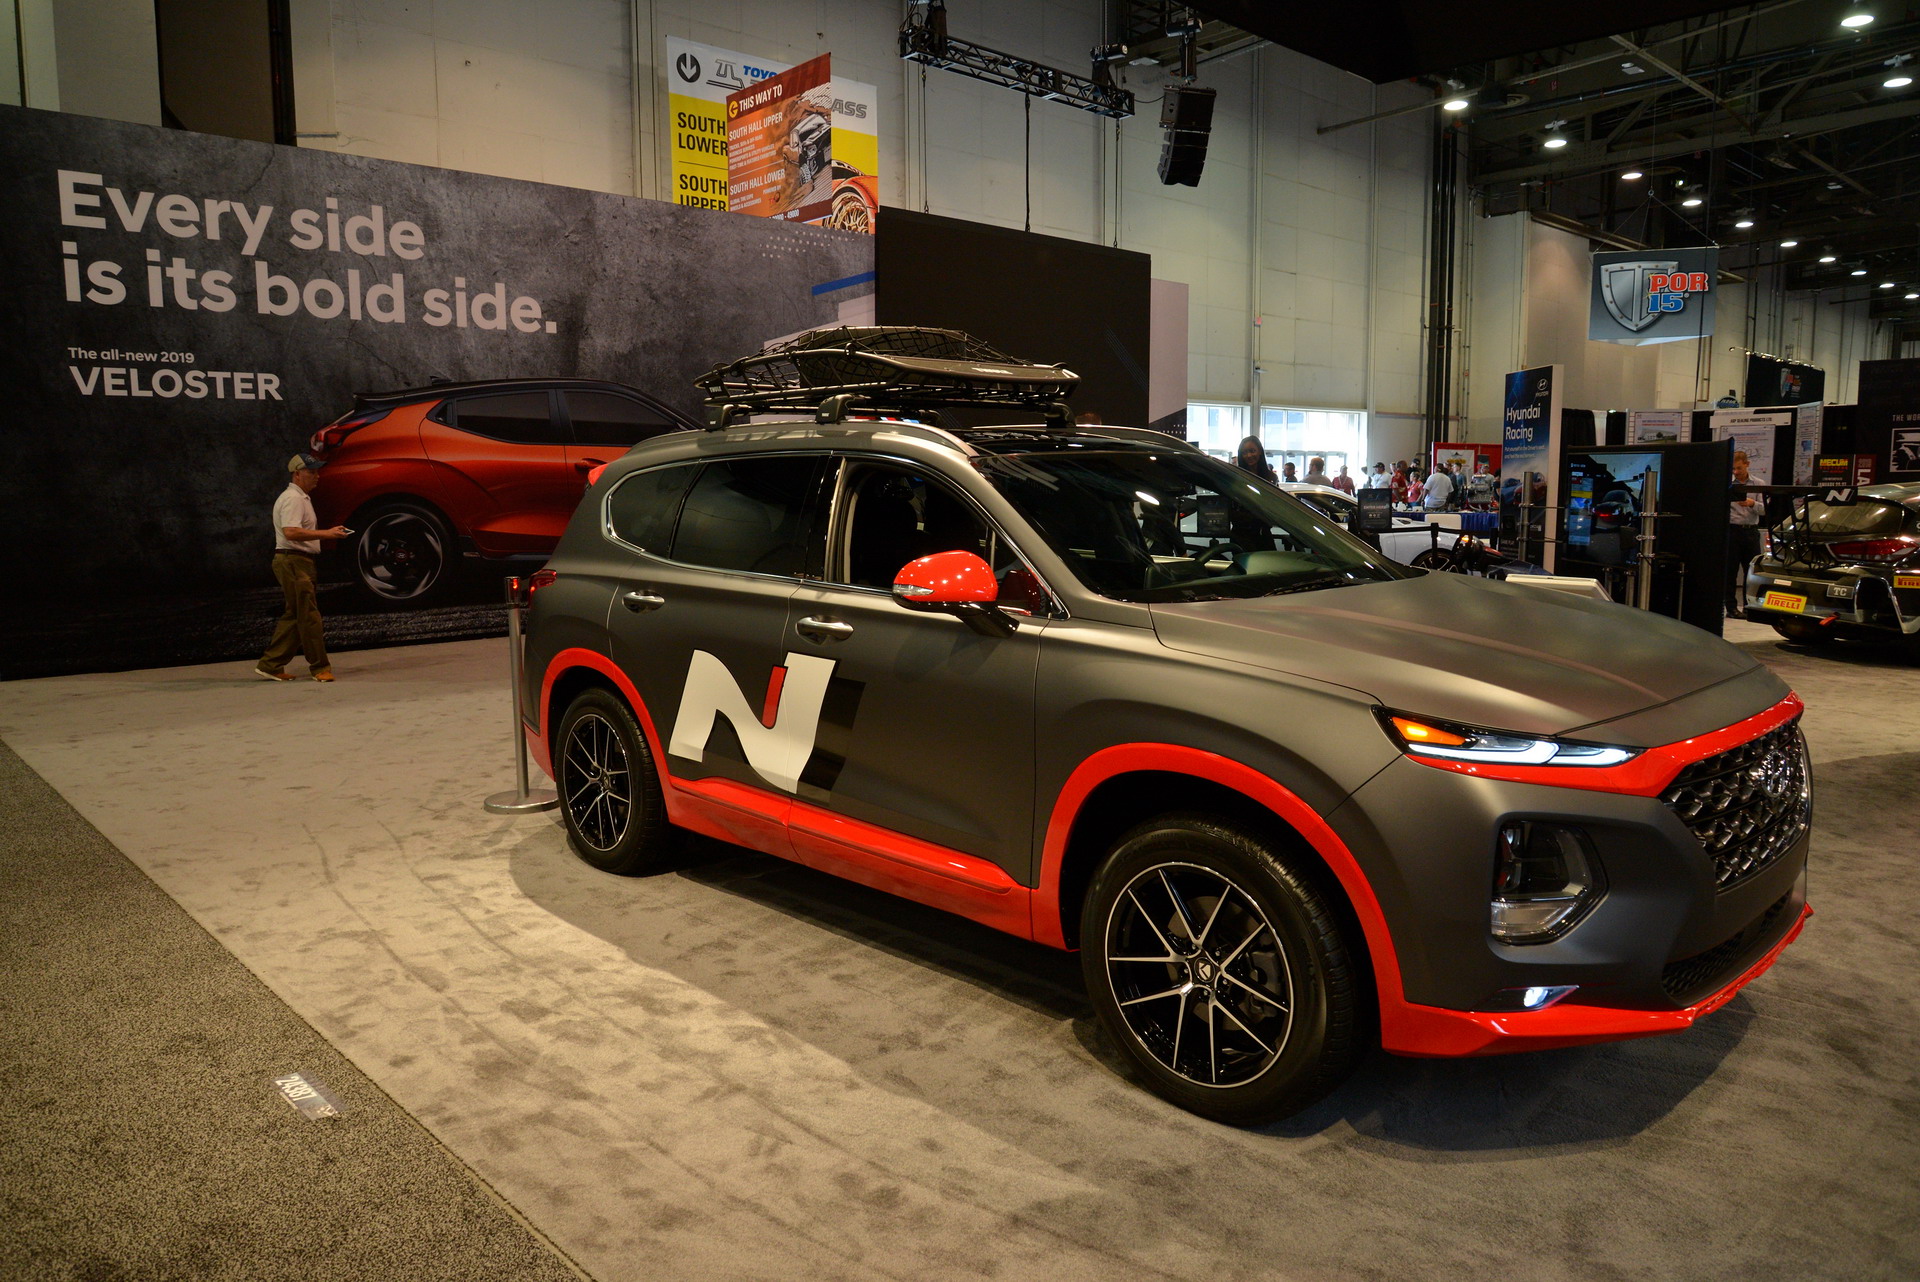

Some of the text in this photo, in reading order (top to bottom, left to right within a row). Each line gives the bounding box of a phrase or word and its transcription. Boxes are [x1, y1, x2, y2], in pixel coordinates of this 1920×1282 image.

[739, 84, 782, 111] THIS WAY TO
[677, 112, 725, 136] SOUTH
[729, 112, 783, 141] SOUTH HALL UPPER
[678, 133, 728, 156] LOWER
[680, 174, 727, 196] SOUTH
[730, 169, 785, 196] SOUTH HALL LOWER
[680, 194, 726, 211] UPPER
[57, 169, 425, 260] Every side
[62, 241, 557, 334] is its bold side.
[1649, 272, 1709, 292] POR
[1648, 292, 1684, 312] 15
[68, 347, 195, 363] The all-new 2019
[69, 365, 283, 401] VELOSTER
[1506, 403, 1541, 423] Hyundai
[1505, 424, 1533, 441] Racing
[1766, 593, 1802, 610] PIRELLI
[1833, 587, 1848, 597] TC
[668, 649, 837, 795] N
[275, 1075, 318, 1101] 24387
